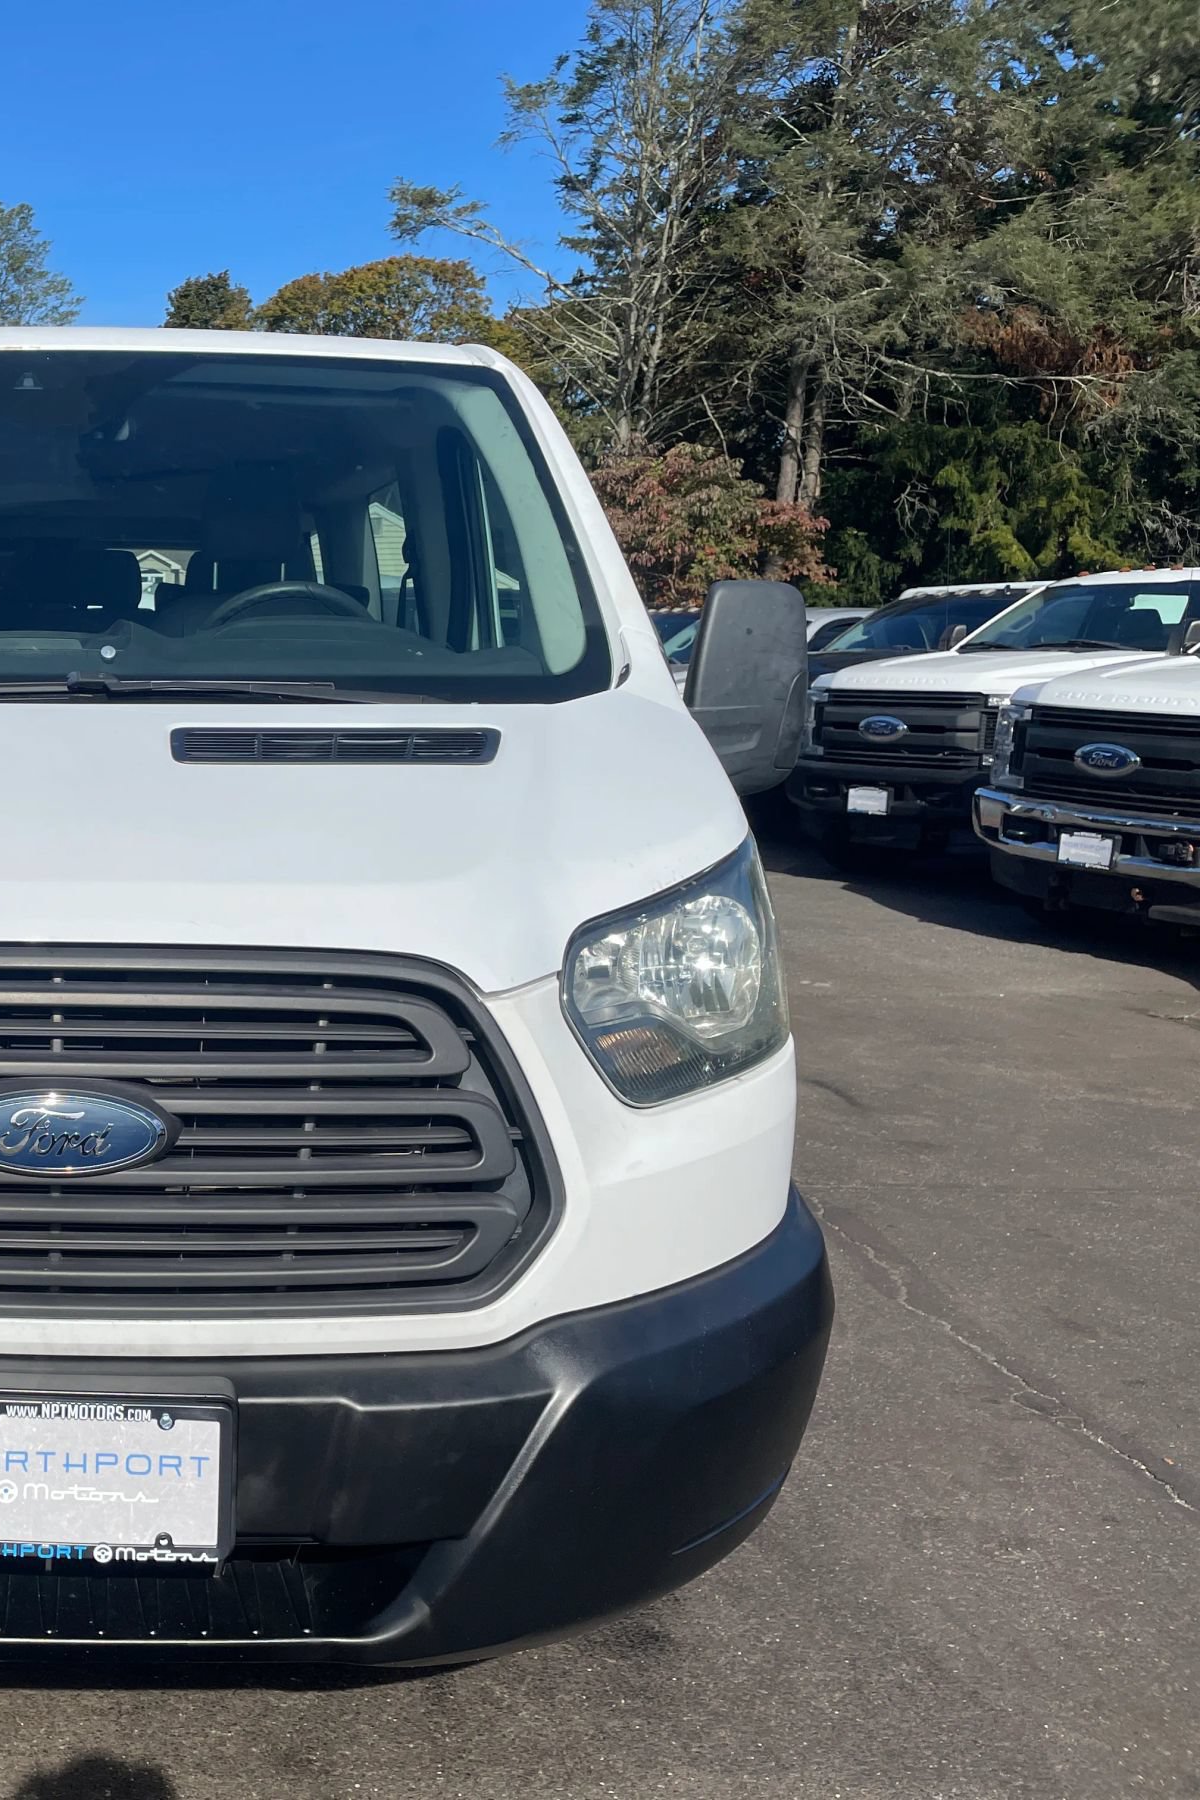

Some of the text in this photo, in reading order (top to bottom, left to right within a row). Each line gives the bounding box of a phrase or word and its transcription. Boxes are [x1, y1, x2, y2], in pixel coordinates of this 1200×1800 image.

[1088, 750, 1119, 768] Ford
[5, 1402, 152, 1422] WWW.NPTMOTORS.COM
[22, 1482, 159, 1503] Motors
[115, 1547, 219, 1563] Motors
